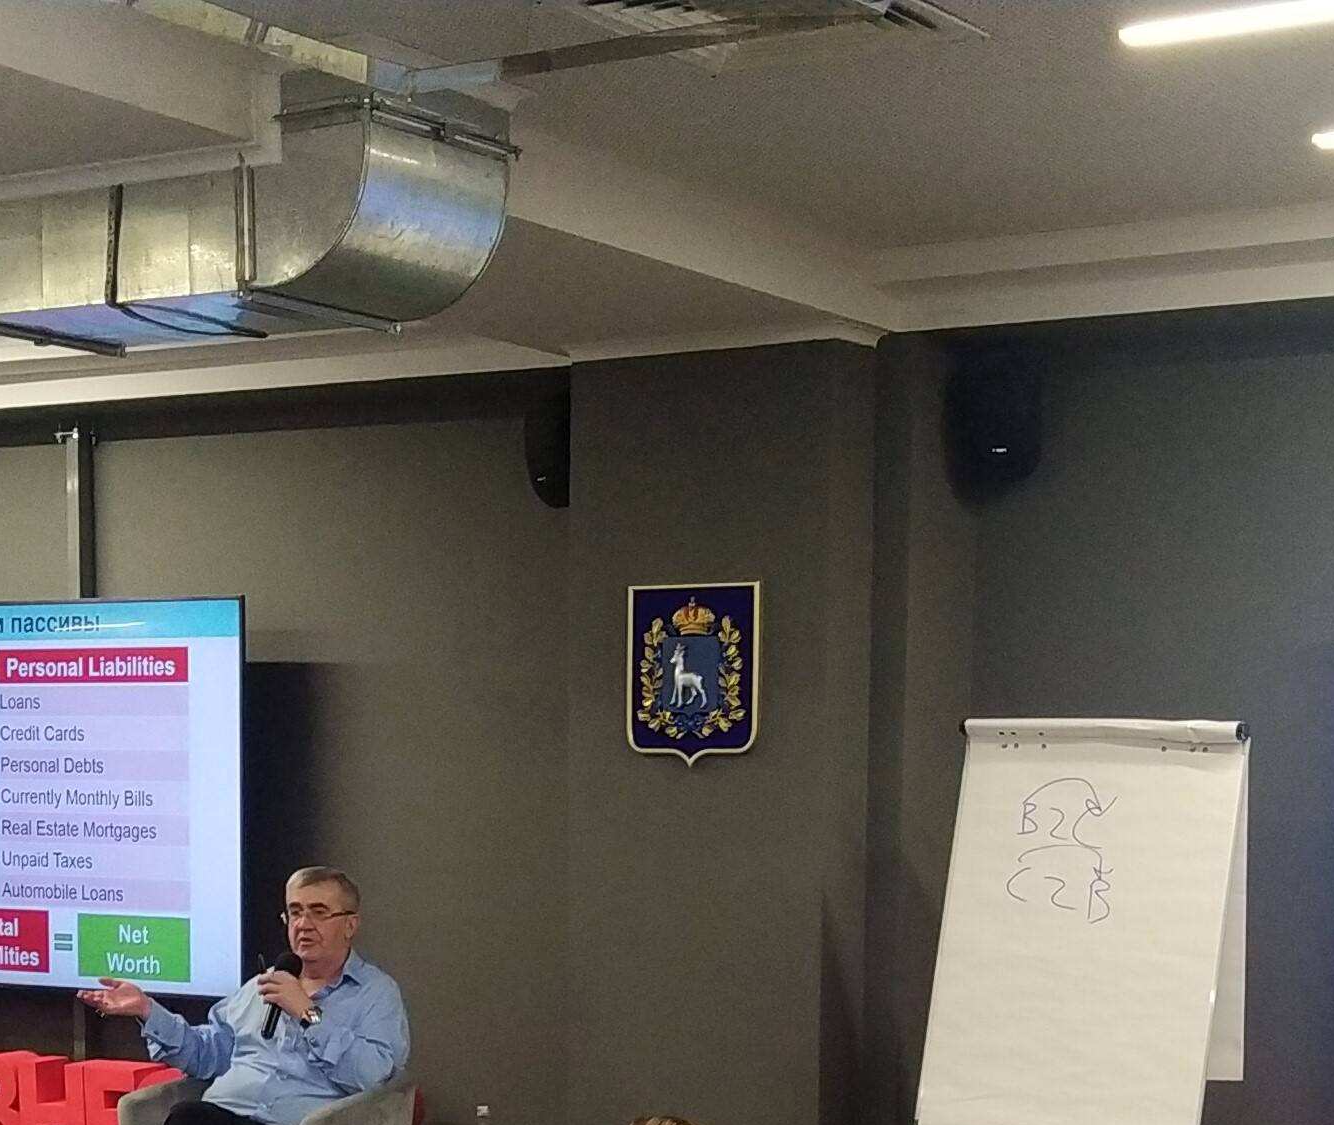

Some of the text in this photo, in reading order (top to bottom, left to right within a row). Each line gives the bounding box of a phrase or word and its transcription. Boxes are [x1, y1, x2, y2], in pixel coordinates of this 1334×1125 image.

[11, 615, 101, 633] пассивы
[6, 655, 176, 678] Personal Liabilities
[0, 693, 41, 710] Loans
[0, 725, 85, 742] Credit Cards
[0, 756, 104, 774] Personal Debts
[0, 787, 154, 810] Currently Monthly Bills
[1, 819, 157, 843] Real Estate Mortgages
[1, 850, 93, 871] Unpaid Taxes
[1, 881, 124, 902] Automobile Loans
[118, 923, 149, 945] Net
[106, 952, 161, 975] Worth
